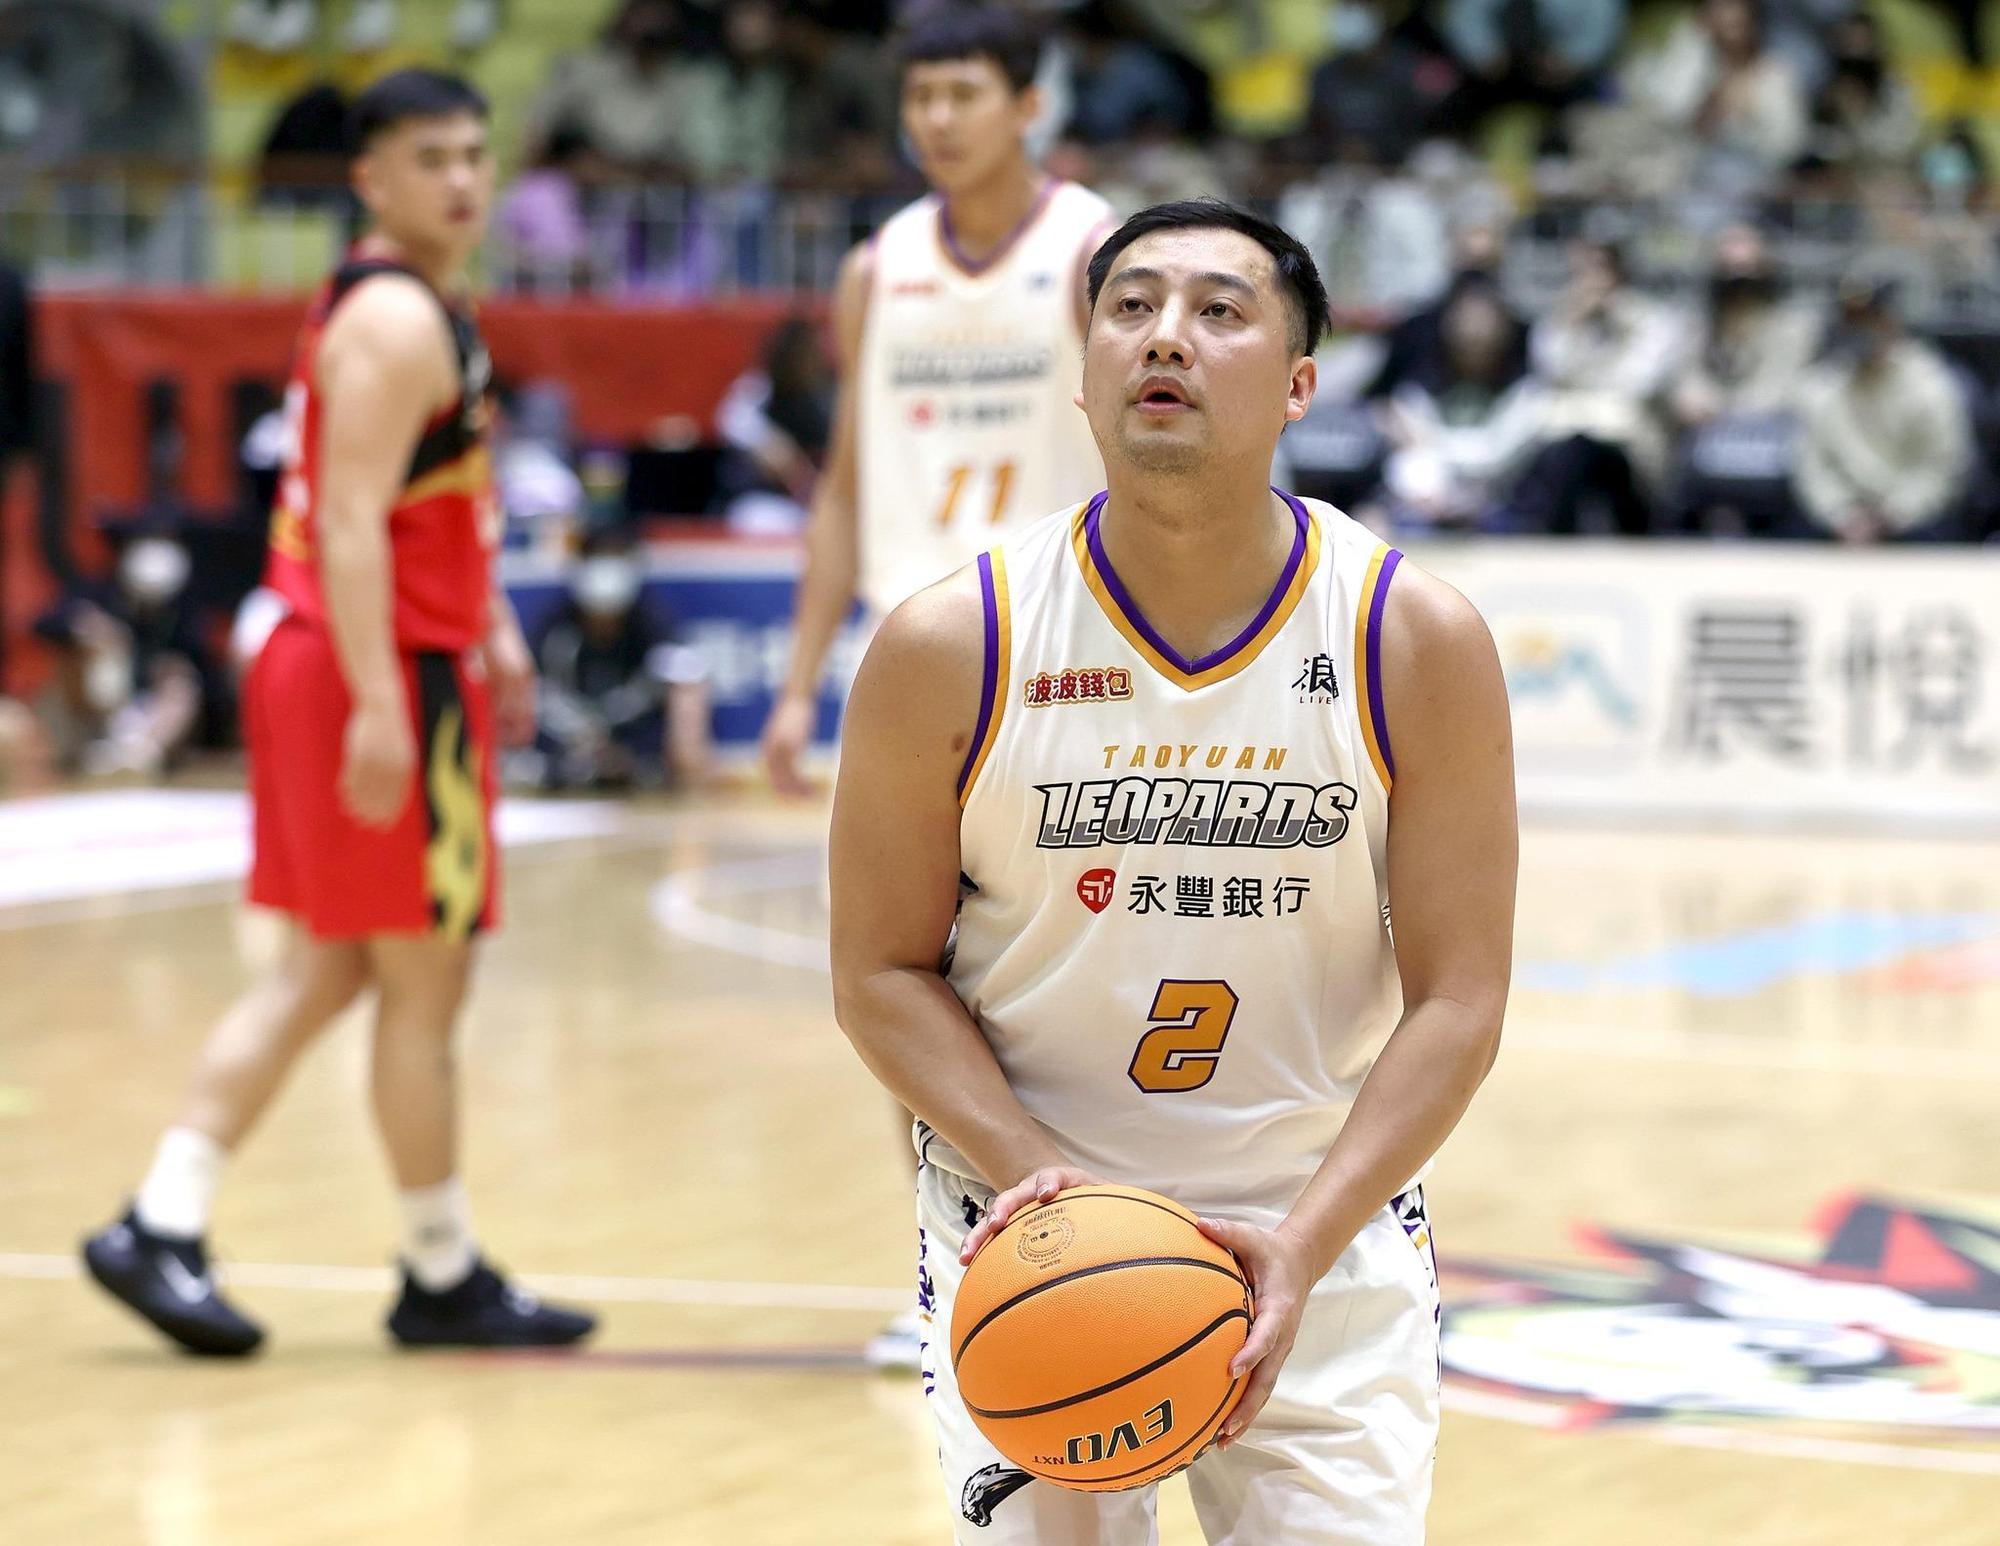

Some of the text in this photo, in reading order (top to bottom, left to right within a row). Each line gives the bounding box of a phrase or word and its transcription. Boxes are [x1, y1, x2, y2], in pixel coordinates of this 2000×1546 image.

[933, 457, 1018, 528] 11
[1026, 669, 1131, 704] 波波錢包
[1299, 695, 1332, 704] LIVE
[1103, 744, 1288, 770] TAOYUAN
[1033, 776, 1357, 849] LEOPARDS
[1127, 875, 1311, 919] 永豐銀行
[1127, 978, 1240, 1094] 2
[1032, 1398, 1174, 1465] EVO NXT
